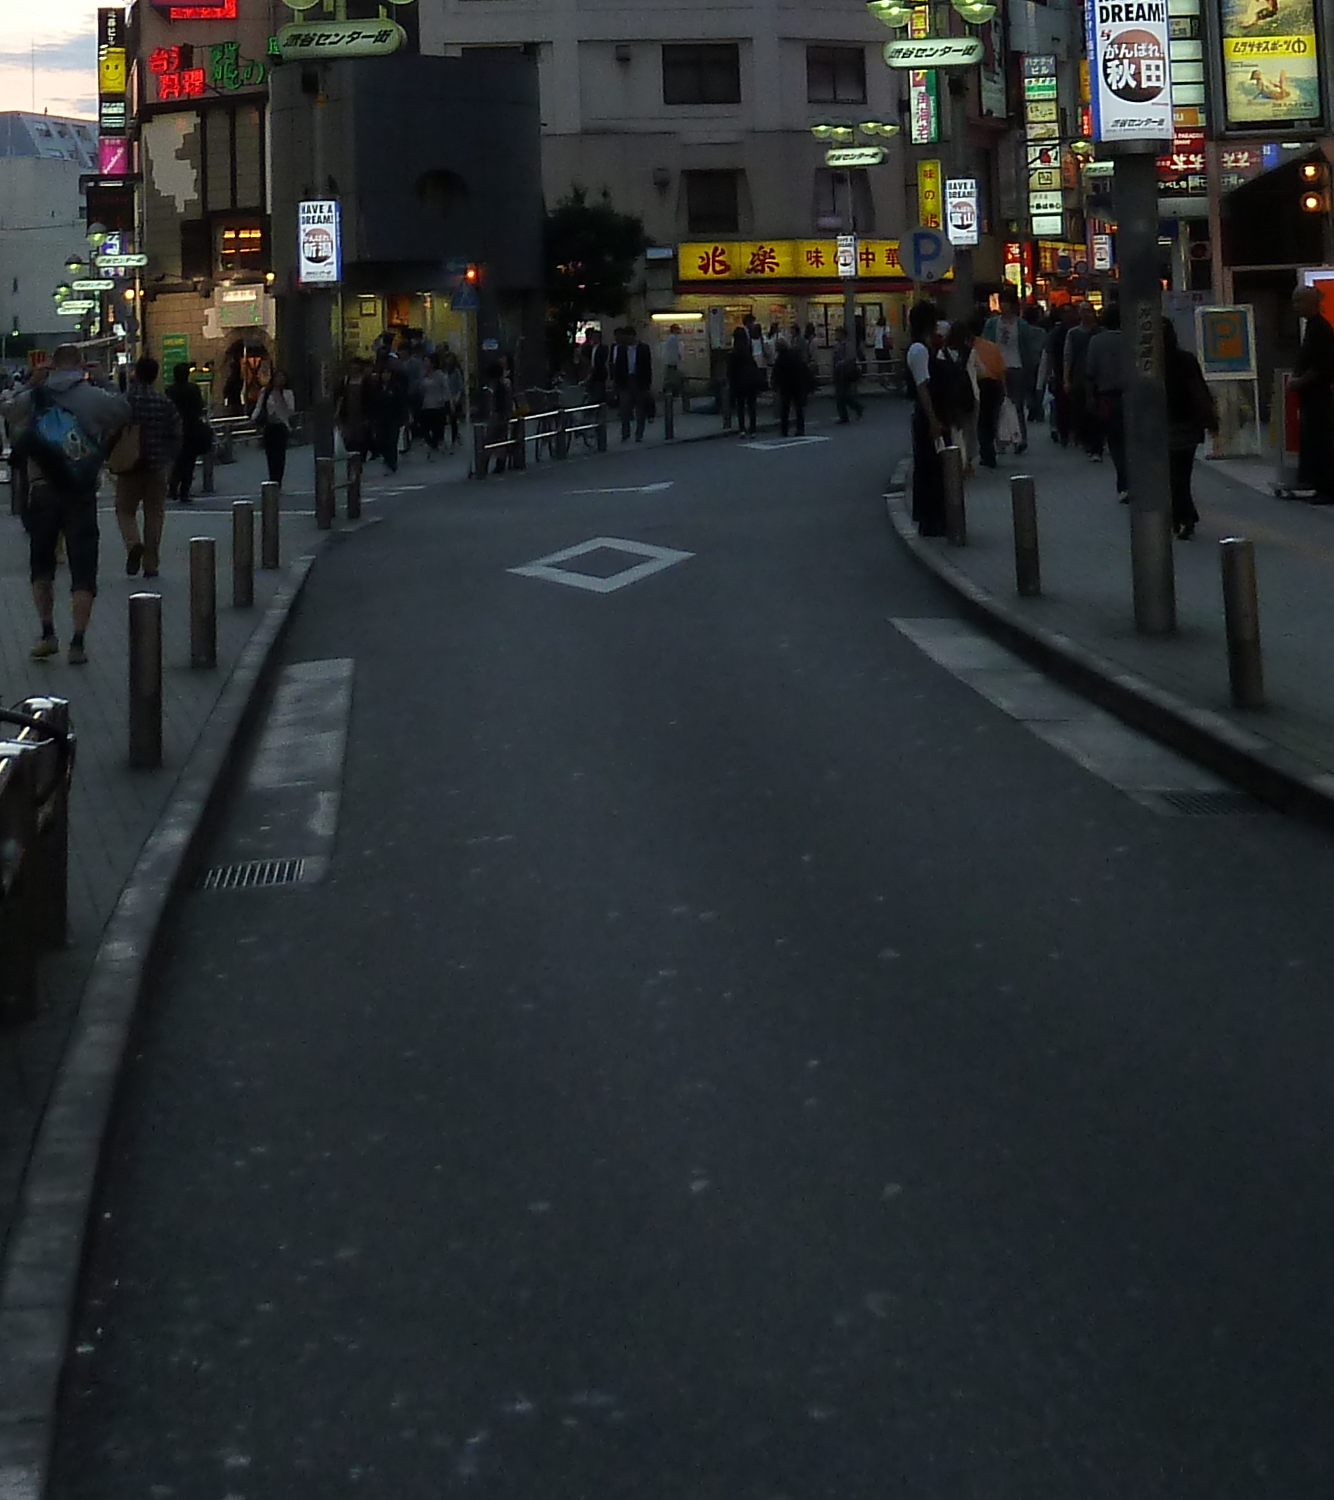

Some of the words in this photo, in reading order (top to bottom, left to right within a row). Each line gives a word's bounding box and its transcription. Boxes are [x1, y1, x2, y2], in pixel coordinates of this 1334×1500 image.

[1099, 3, 1165, 24] DREAM!
[283, 29, 393, 48] 渋谷センター街
[889, 43, 978, 59] 渋谷センター街
[1107, 60, 1165, 90] 秋田
[698, 246, 779, 275] 兆楽
[806, 247, 900, 269] 味中華
[912, 232, 942, 277] P
